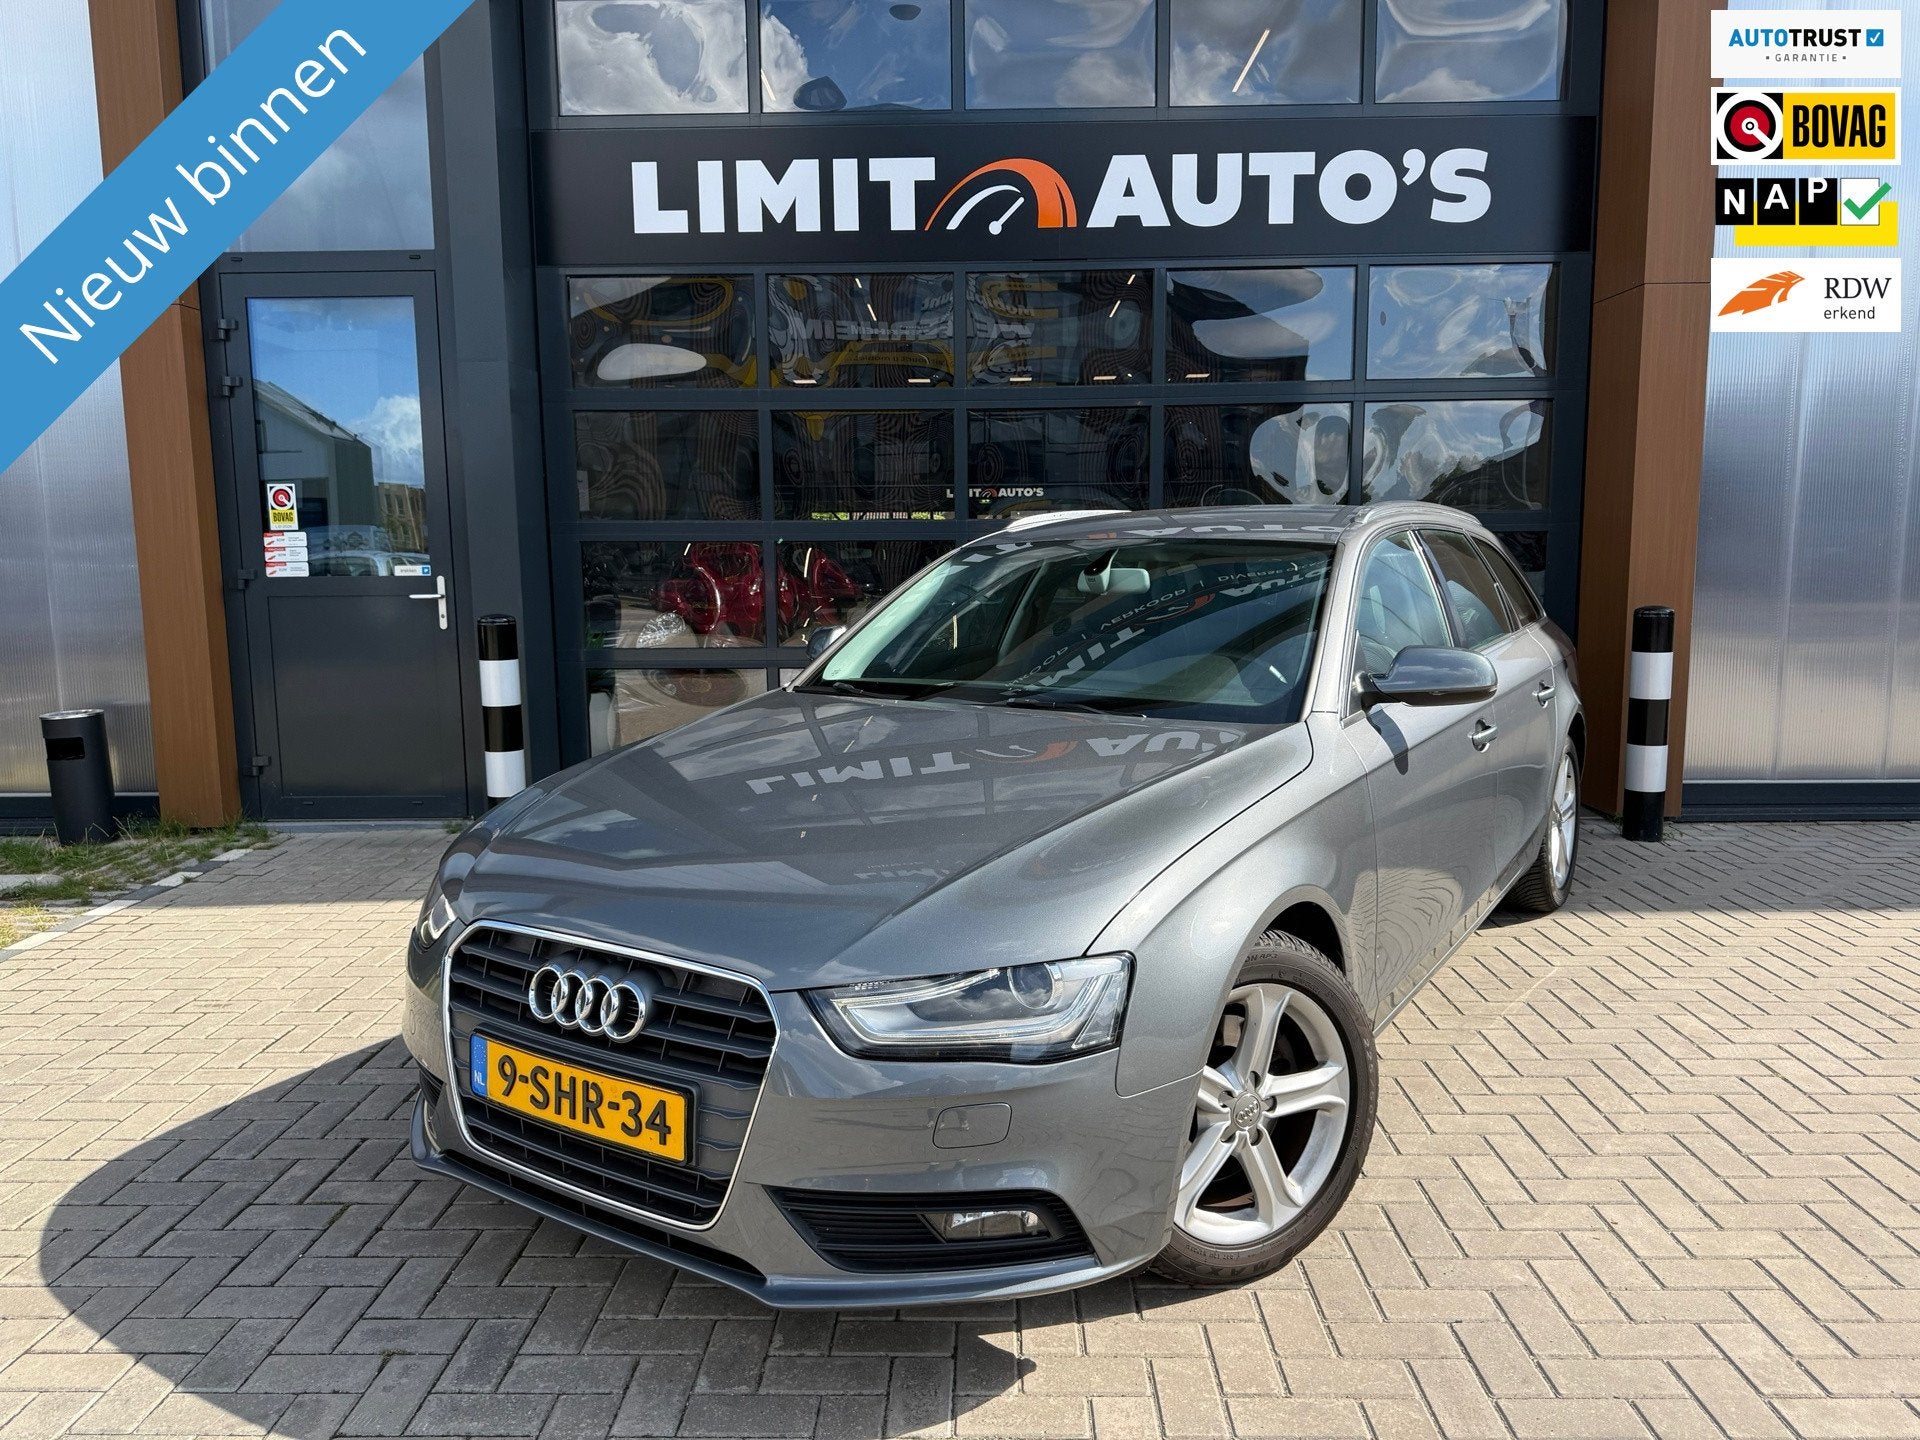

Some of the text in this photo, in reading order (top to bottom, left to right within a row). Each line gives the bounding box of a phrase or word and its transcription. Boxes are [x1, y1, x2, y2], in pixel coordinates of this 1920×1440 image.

[631, 147, 1493, 235] LIMIT AUTO'S
[946, 487, 1044, 498] LIT AUTO'S
[272, 512, 294, 523] BOVAG
[474, 1069, 485, 1086] NL
[497, 1054, 671, 1146] 9-SHR-34
